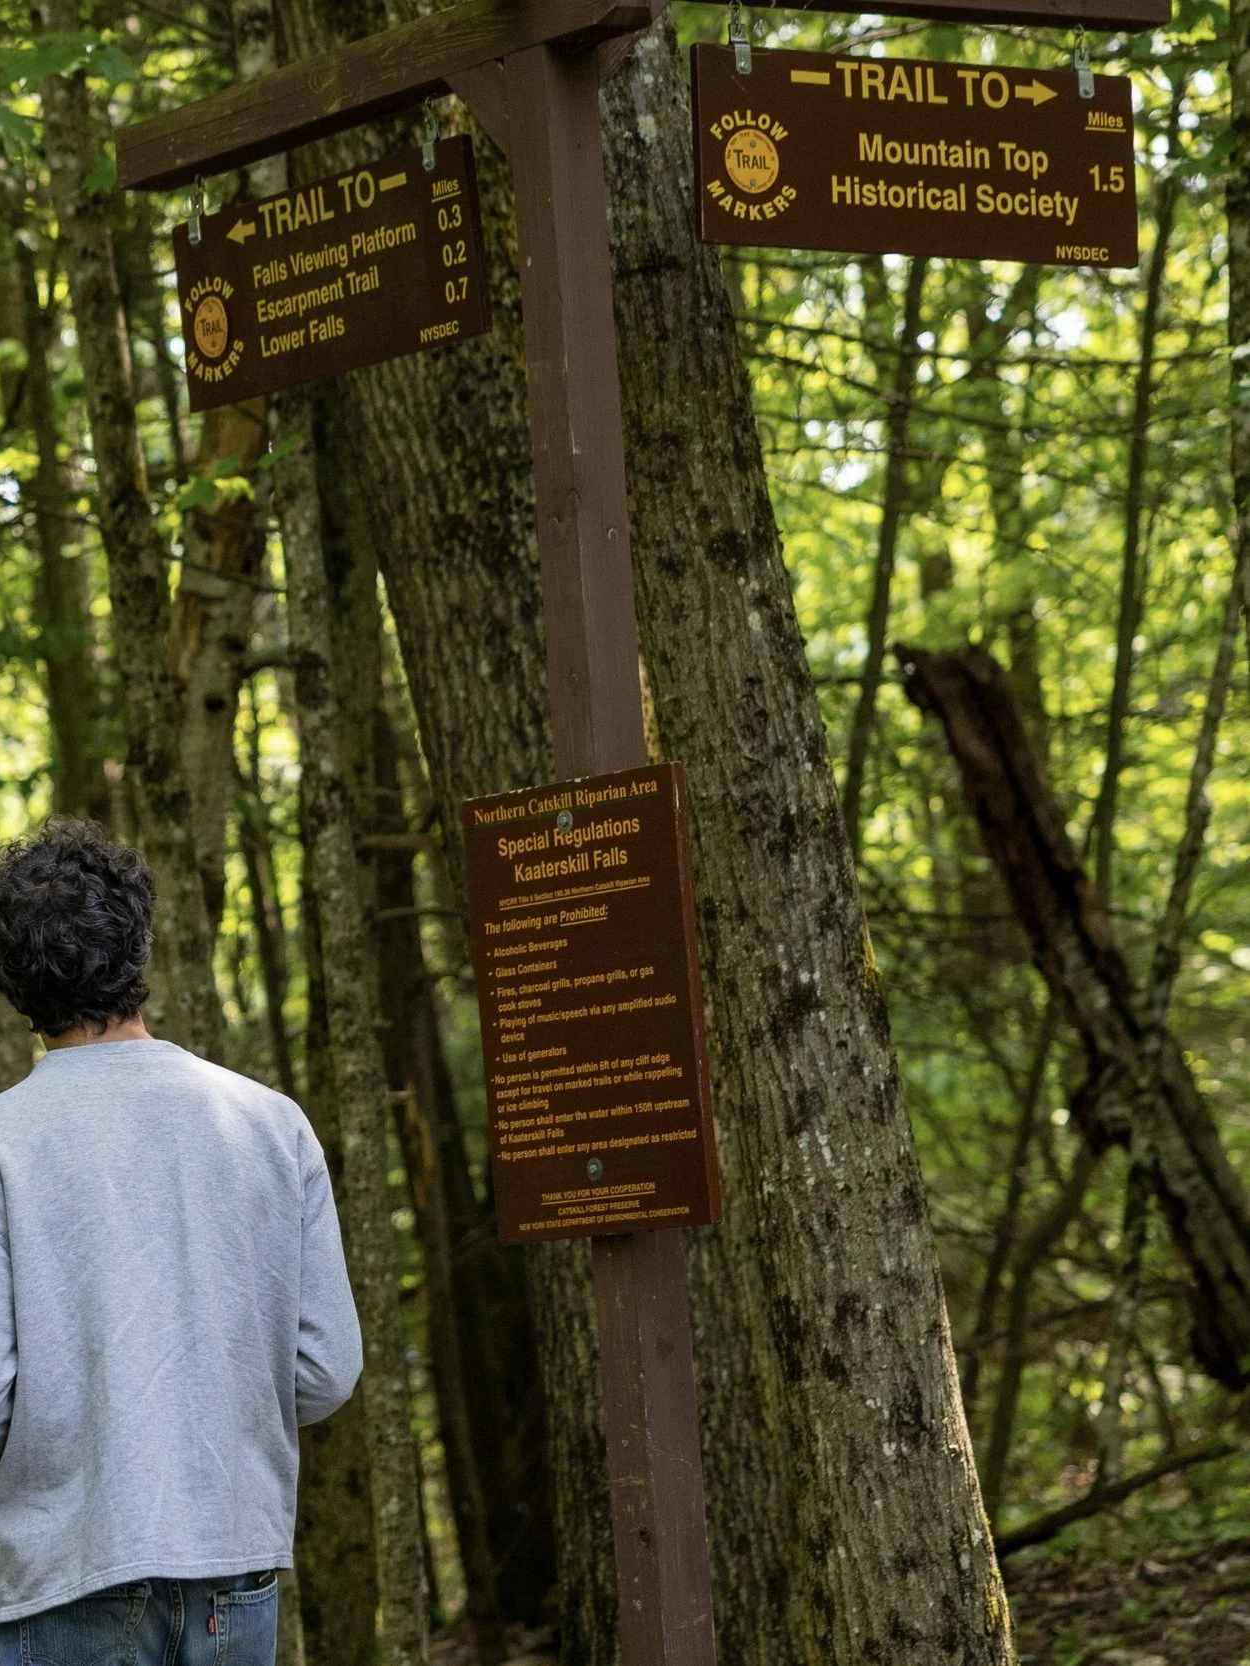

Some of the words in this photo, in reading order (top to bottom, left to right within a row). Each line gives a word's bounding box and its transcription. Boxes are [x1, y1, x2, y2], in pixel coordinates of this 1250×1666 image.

[836, 61, 948, 105] TRAIL
[957, 70, 1009, 109] TO
[710, 109, 789, 142] FOLLOW
[1088, 112, 1124, 128] Miles
[733, 149, 771, 170] TRAIL
[858, 132, 990, 169] Mountain
[998, 142, 1049, 180] Top
[432, 178, 459, 197] Miles
[1090, 164, 1125, 193] 1.5
[258, 186, 335, 239] TRAIL
[338, 170, 375, 214] TO
[706, 180, 797, 221] MARKERS
[831, 175, 966, 212] Historical
[976, 184, 1079, 226] Society
[438, 204, 462, 231] 0.3
[253, 260, 288, 289] Falls
[290, 244, 348, 276] Viewing
[351, 222, 417, 259] Platform
[442, 240, 467, 268] 0.2
[1056, 245, 1109, 261] NYSDEC
[184, 276, 234, 313] FOLLOW
[256, 277, 344, 323] Escarpment
[346, 266, 379, 296] Trail
[445, 276, 469, 304] 0.7
[200, 318, 223, 337] TRAIL
[260, 328, 305, 358] Lower
[309, 314, 345, 344] Falls
[420, 320, 459, 343] NYSDEC
[187, 340, 244, 383] MARKERS
[474, 805, 525, 825] Northern
[529, 794, 572, 815] Catskill
[576, 786, 626, 808] Riparian
[630, 779, 657, 796] Area
[499, 830, 549, 860] Special
[554, 817, 640, 848] Regulations
[514, 856, 589, 883] Kaaterskill
[594, 847, 628, 869] Falls
[484, 923, 501, 935] The
[503, 916, 542, 932] following
[544, 914, 558, 925] are
[560, 904, 608, 922] Prohibited:
[494, 944, 527, 957] Alcoholic
[529, 938, 568, 952] Beverages
[496, 967, 516, 978] Glass
[518, 960, 557, 974] Containers
[497, 987, 518, 998] Fires,
[519, 980, 550, 994] charcoal
[552, 978, 573, 992] grills,
[574, 974, 605, 988] propane
[607, 968, 628, 983] grills,
[630, 968, 638, 978] or
[640, 966, 654, 979] gas
[498, 1000, 516, 1012] cook
[518, 998, 542, 1010] stoves
[500, 1016, 527, 1030] Playing
[528, 1014, 535, 1024] of
[590, 1004, 600, 1016] via
[603, 1004, 616, 1015] any
[618, 996, 653, 1012] amplified
[655, 993, 677, 1005] audio
[501, 1031, 525, 1044] device
[502, 1052, 517, 1063] Use
[519, 1050, 526, 1061] of
[528, 1046, 567, 1062] generators
[507, 1072, 532, 1086] person
[532, 1070, 539, 1080] is
[541, 1065, 575, 1080] permitted
[576, 1062, 598, 1073] within
[611, 1058, 619, 1069] of
[620, 1059, 634, 1069] any
[636, 1054, 650, 1066] cliff
[652, 1052, 670, 1065] edge
[496, 1088, 520, 1099] except
[521, 1086, 531, 1096] for
[532, 1082, 553, 1094] travel
[554, 1083, 564, 1091] on
[565, 1077, 592, 1090] marked
[594, 1075, 612, 1086] trails
[614, 1075, 622, 1084] or
[623, 1070, 643, 1082] while
[644, 1066, 682, 1081] rappelling
[498, 1105, 505, 1114] or
[506, 1103, 517, 1113] ice
[519, 1098, 549, 1111] climbing
[510, 1118, 535, 1131] person
[536, 1114, 554, 1126] shall
[555, 1112, 574, 1123] enter
[575, 1110, 587, 1121] the
[588, 1108, 609, 1120] water
[610, 1104, 633, 1116] within
[654, 1098, 690, 1112] upstream
[500, 1134, 507, 1144] of
[508, 1129, 545, 1143] Kaaterskill
[547, 1128, 564, 1139] Falls
[513, 1149, 537, 1162] person
[538, 1145, 555, 1156] shall
[557, 1144, 576, 1154] enter
[577, 1143, 590, 1154] any
[592, 1140, 608, 1151] area
[610, 1134, 649, 1149] designated
[650, 1134, 660, 1143] as
[662, 1128, 697, 1142] restricted
[542, 1192, 562, 1202] THANK
[563, 1191, 577, 1200] YOU
[578, 1190, 591, 1198] FOR
[592, 1187, 609, 1197] YOUR
[610, 1182, 656, 1195] COOPERATION
[558, 1205, 585, 1216] CATSKILL
[586, 1202, 609, 1213] FOREST
[610, 1200, 641, 1210] PRESERVE
